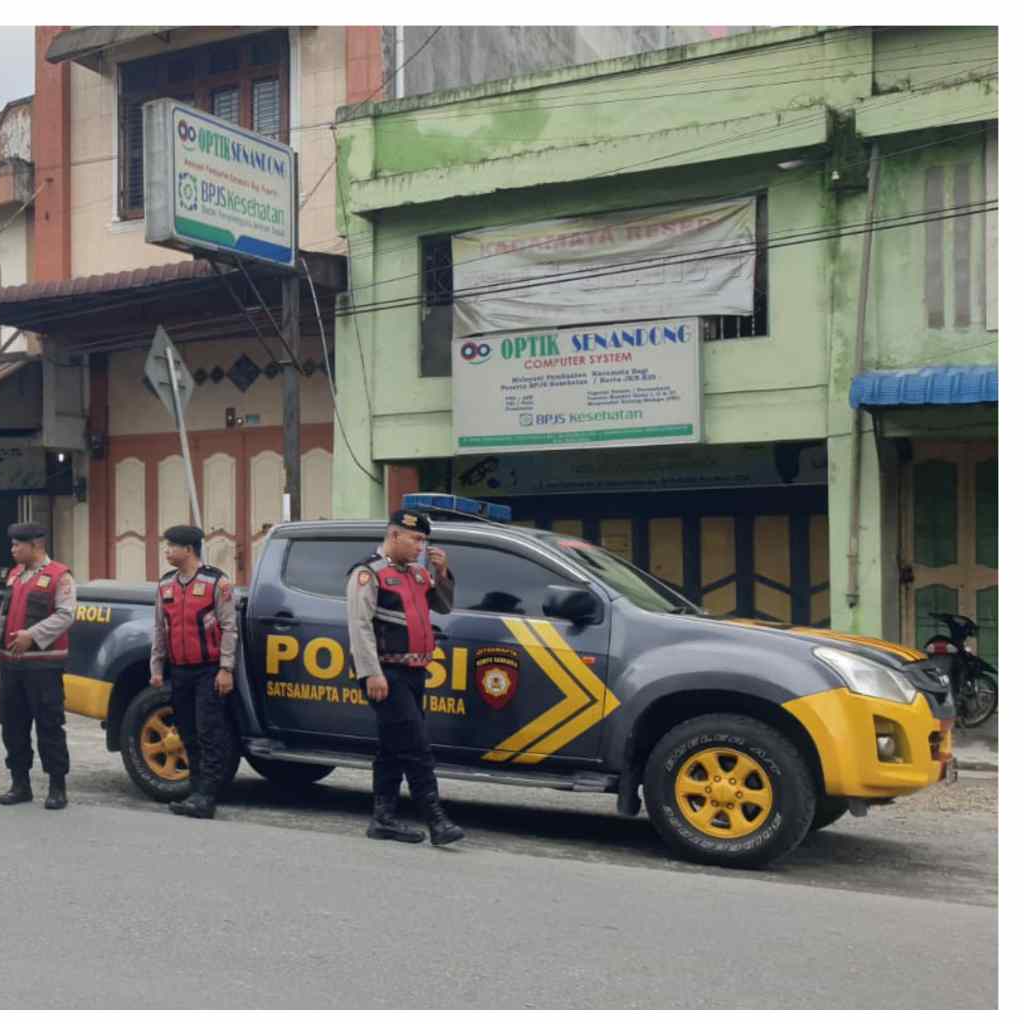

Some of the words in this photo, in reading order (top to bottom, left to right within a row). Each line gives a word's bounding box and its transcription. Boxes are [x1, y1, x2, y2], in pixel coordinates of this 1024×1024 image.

[199, 127, 230, 161] OPTIK
[201, 180, 225, 207] BPJS
[225, 190, 286, 225] Kesehatan
[501, 333, 560, 360] OPTIK
[571, 324, 690, 352] SENANDONG
[524, 357, 586, 370] COMPUTER
[590, 351, 633, 364] SYSTEM
[536, 413, 565, 425] BPJS
[569, 409, 642, 423] Kesehatan
[265, 634, 468, 691] POSI
[266, 680, 340, 703] SATSAMAPTA
[430, 694, 465, 715] BARA
